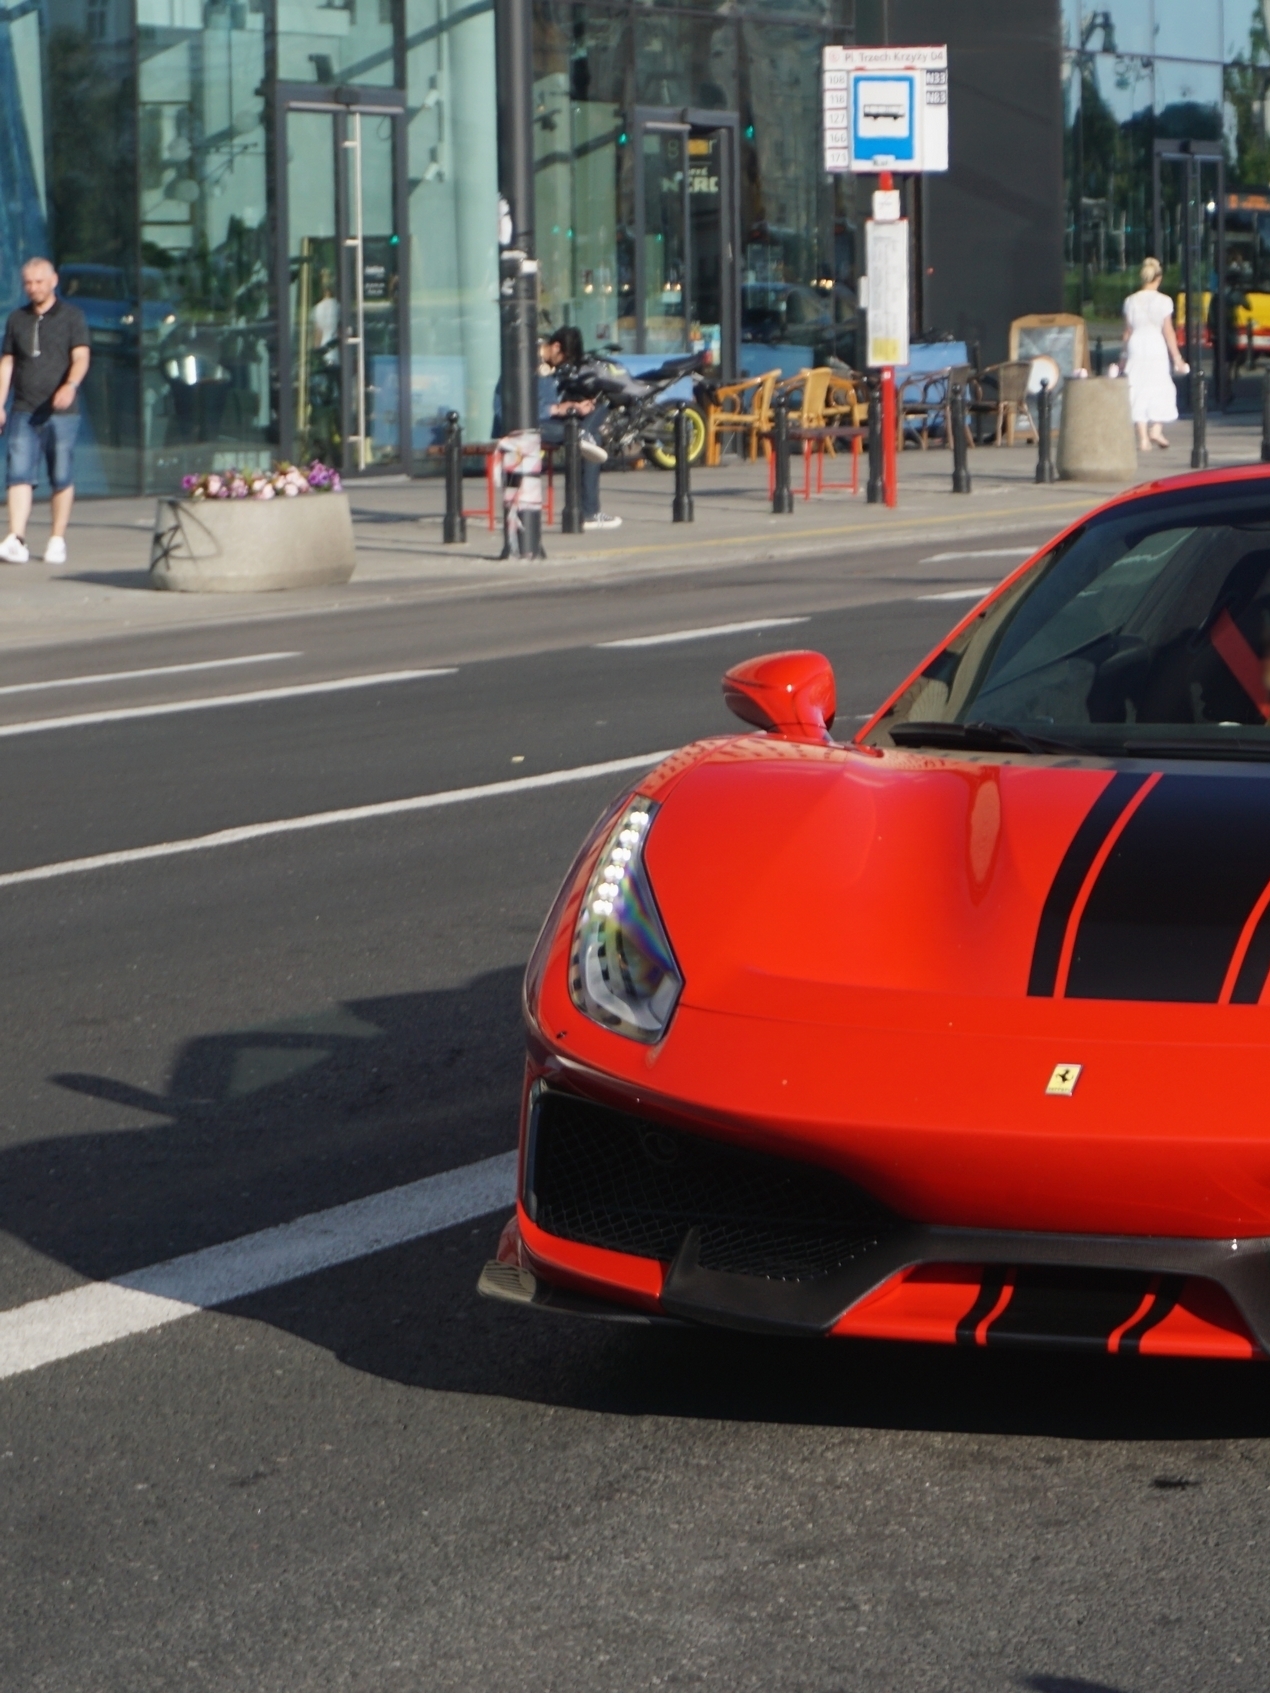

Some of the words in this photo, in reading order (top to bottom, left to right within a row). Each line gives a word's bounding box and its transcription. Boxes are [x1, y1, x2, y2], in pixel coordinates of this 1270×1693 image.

[859, 51, 891, 62] Trzech
[828, 75, 845, 85] 108
[829, 113, 845, 124] 127
